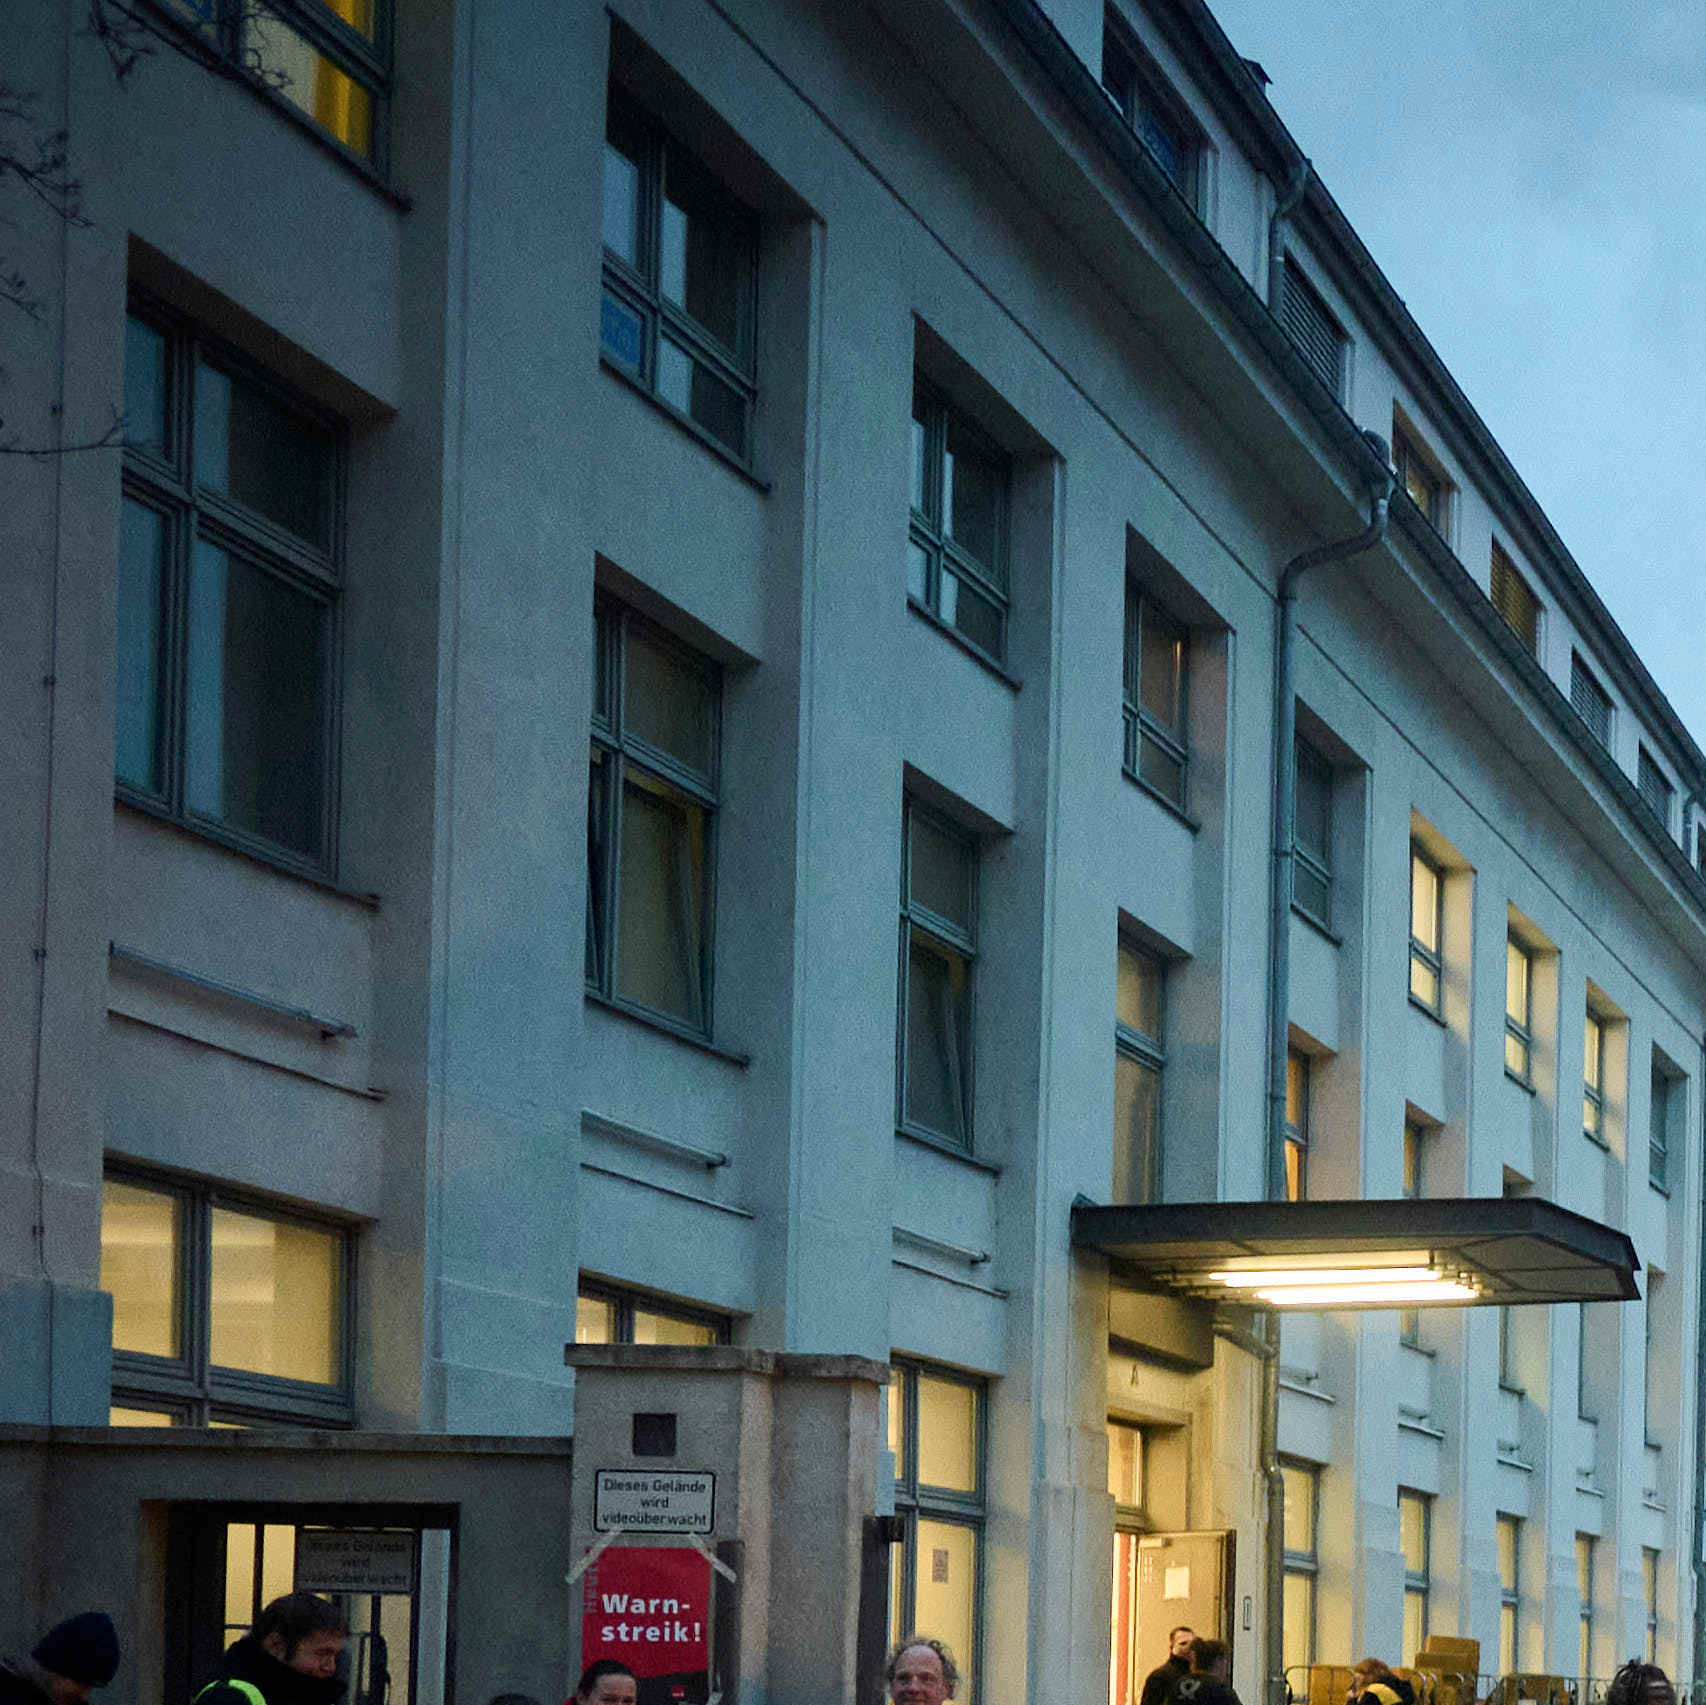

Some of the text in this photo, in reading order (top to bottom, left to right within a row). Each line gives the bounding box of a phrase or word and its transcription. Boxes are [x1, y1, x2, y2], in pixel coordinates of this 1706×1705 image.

[603, 1478, 706, 1493] Dieses Gelände
[640, 1497, 669, 1509] wird
[602, 1512, 706, 1526] videoüberwacht
[602, 1593, 690, 1614] Warn-
[601, 1621, 700, 1642] streik!
